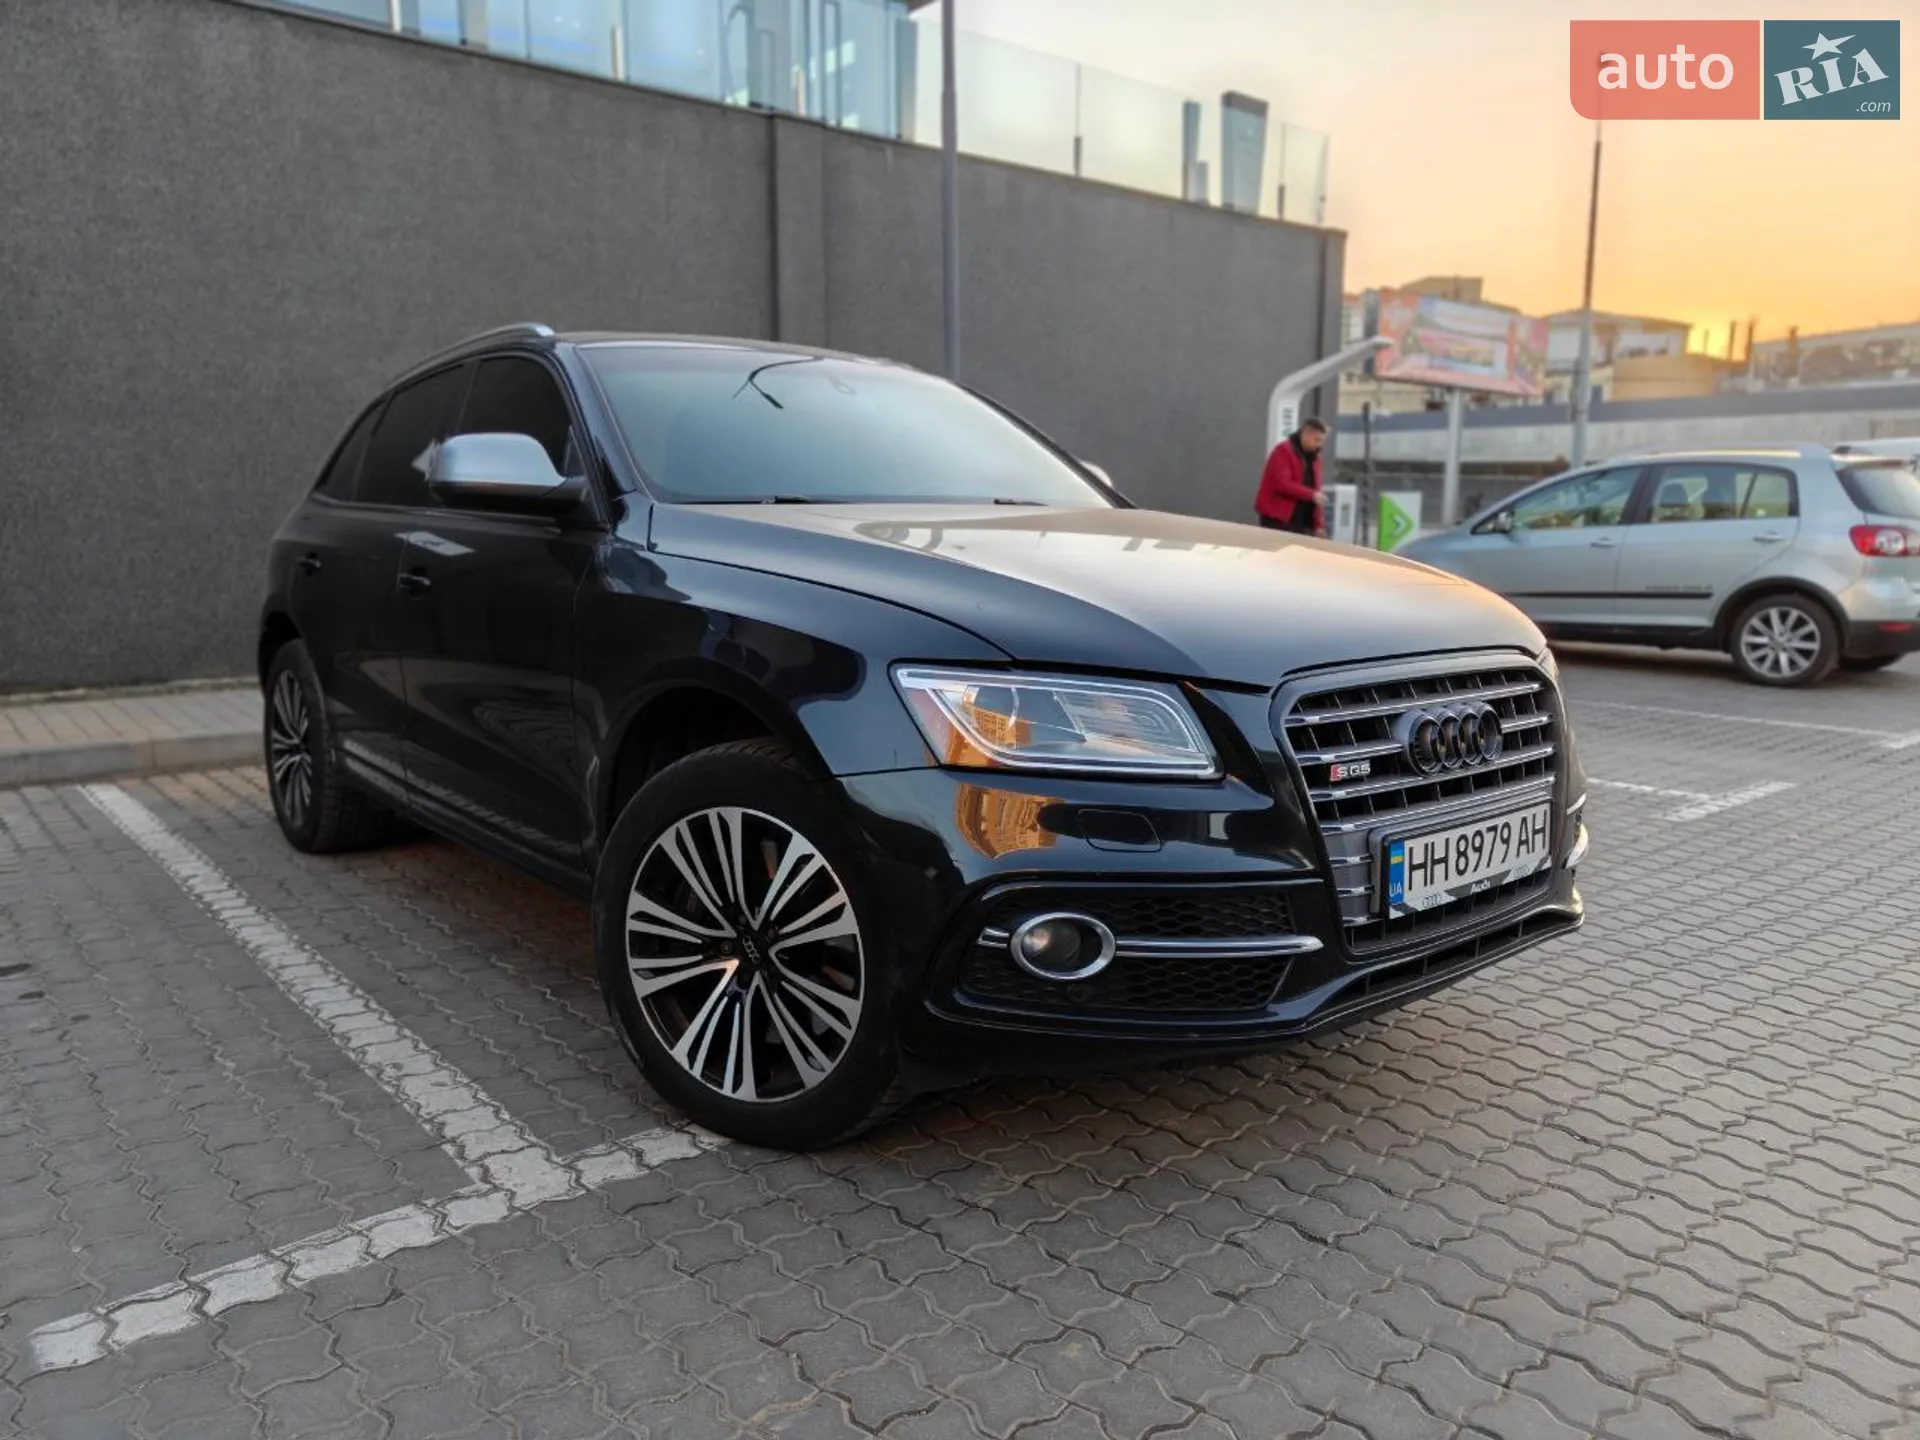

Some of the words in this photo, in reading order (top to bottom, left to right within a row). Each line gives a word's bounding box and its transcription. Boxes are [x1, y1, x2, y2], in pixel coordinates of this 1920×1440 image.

[1408, 838, 1450, 891] HH
[1455, 821, 1512, 876] 8979
[1516, 809, 1548, 858] AH
[1389, 882, 1403, 898] UA
